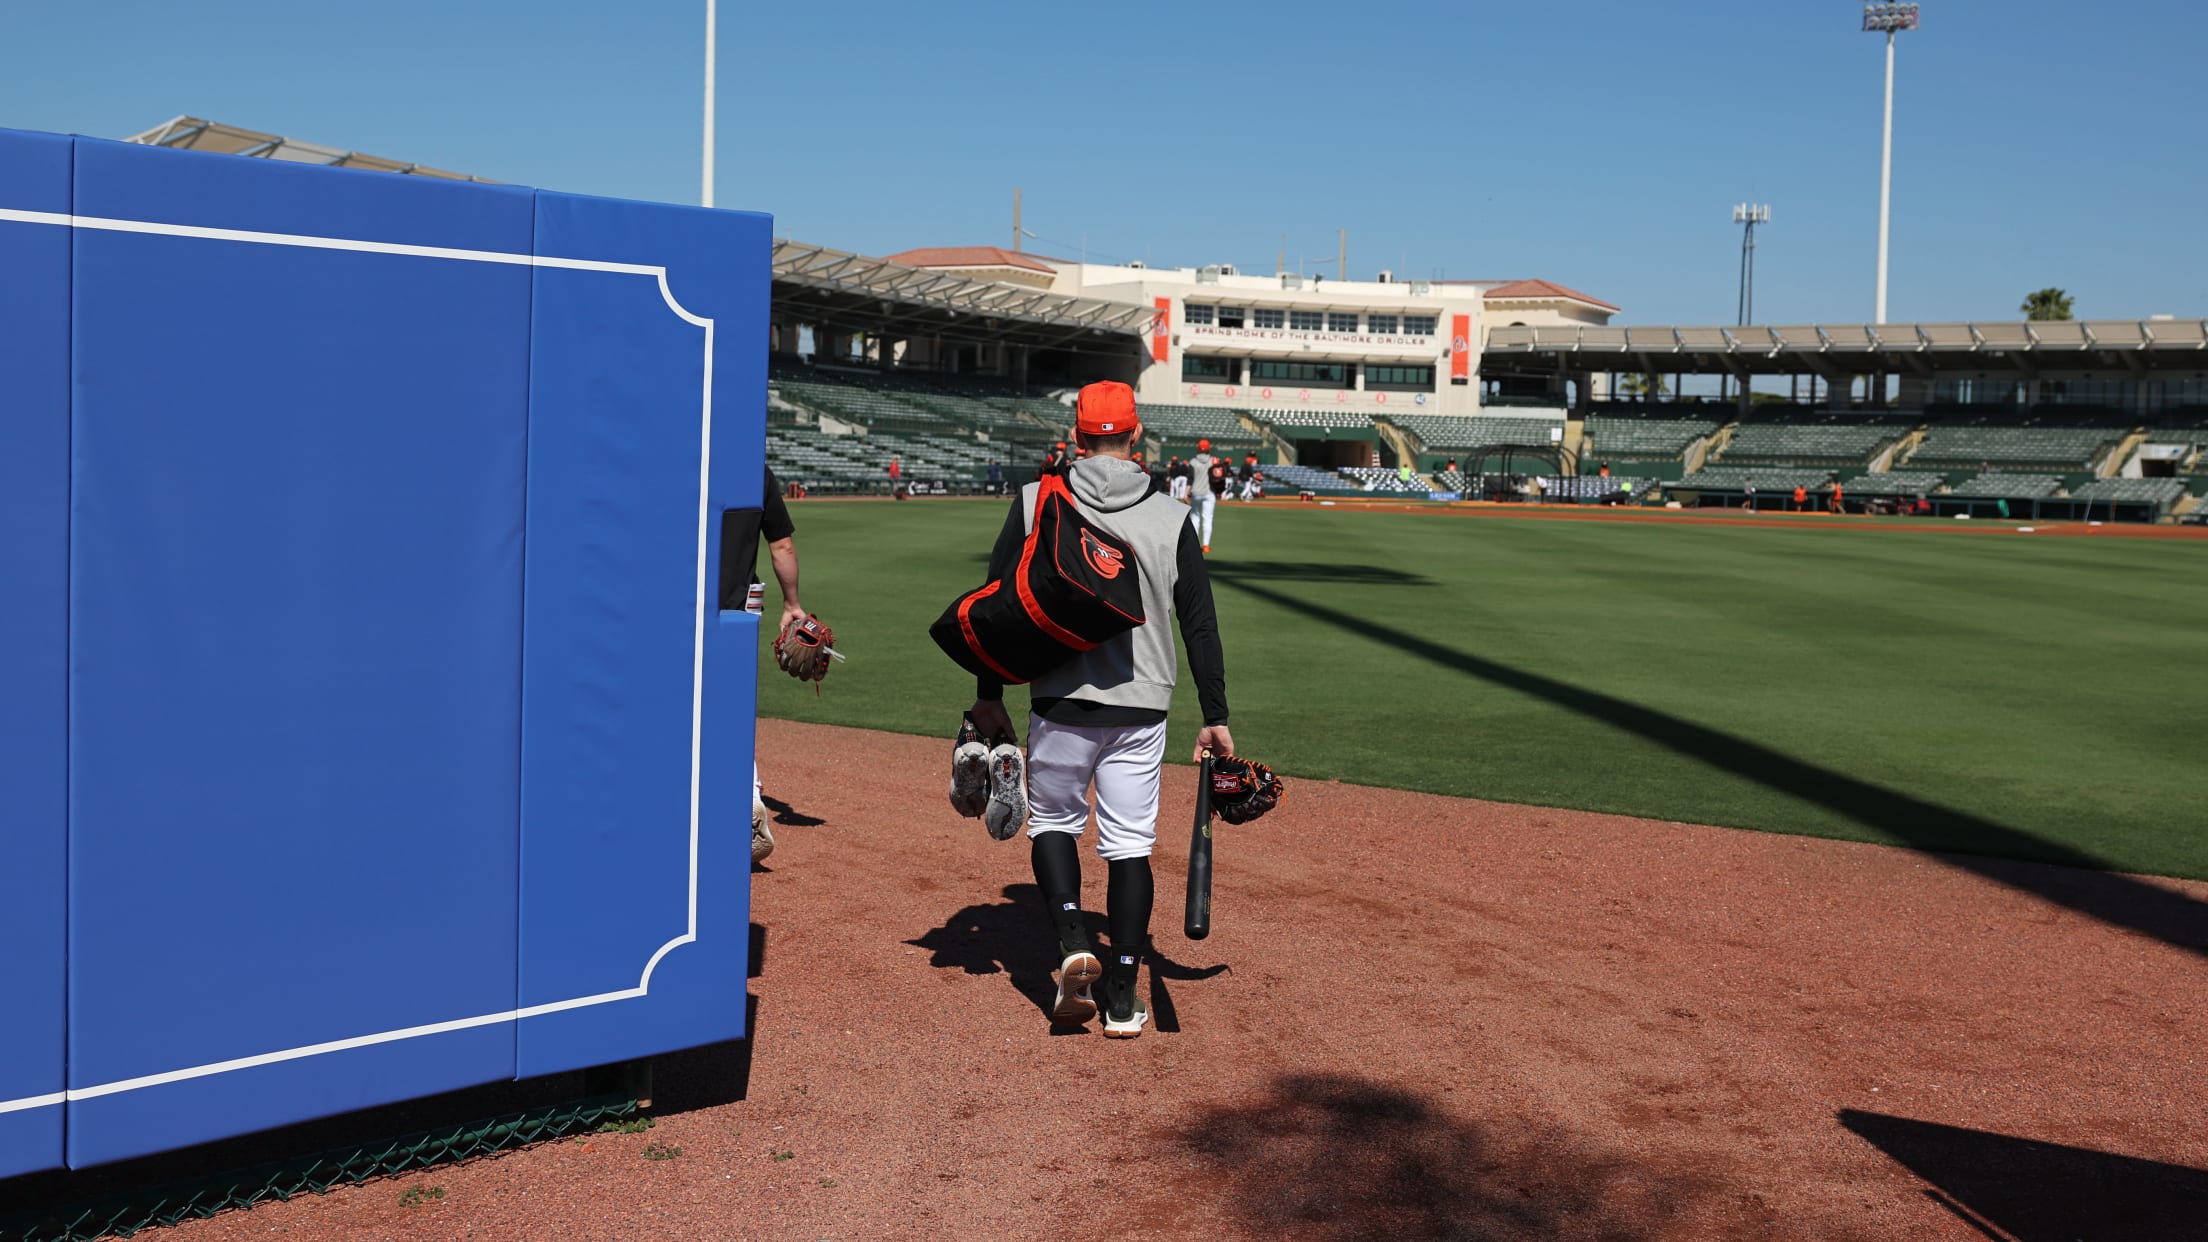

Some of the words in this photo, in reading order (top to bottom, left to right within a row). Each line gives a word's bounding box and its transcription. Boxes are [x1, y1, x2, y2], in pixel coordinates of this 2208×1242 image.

[1195, 327, 1232, 336] SPRING
[1236, 330, 1265, 338] HOME
[1271, 331, 1284, 339] OF
[1290, 332, 1308, 340] THE
[1314, 334, 1371, 343] BALTIMORE
[1377, 336, 1425, 345] ORIOLES
